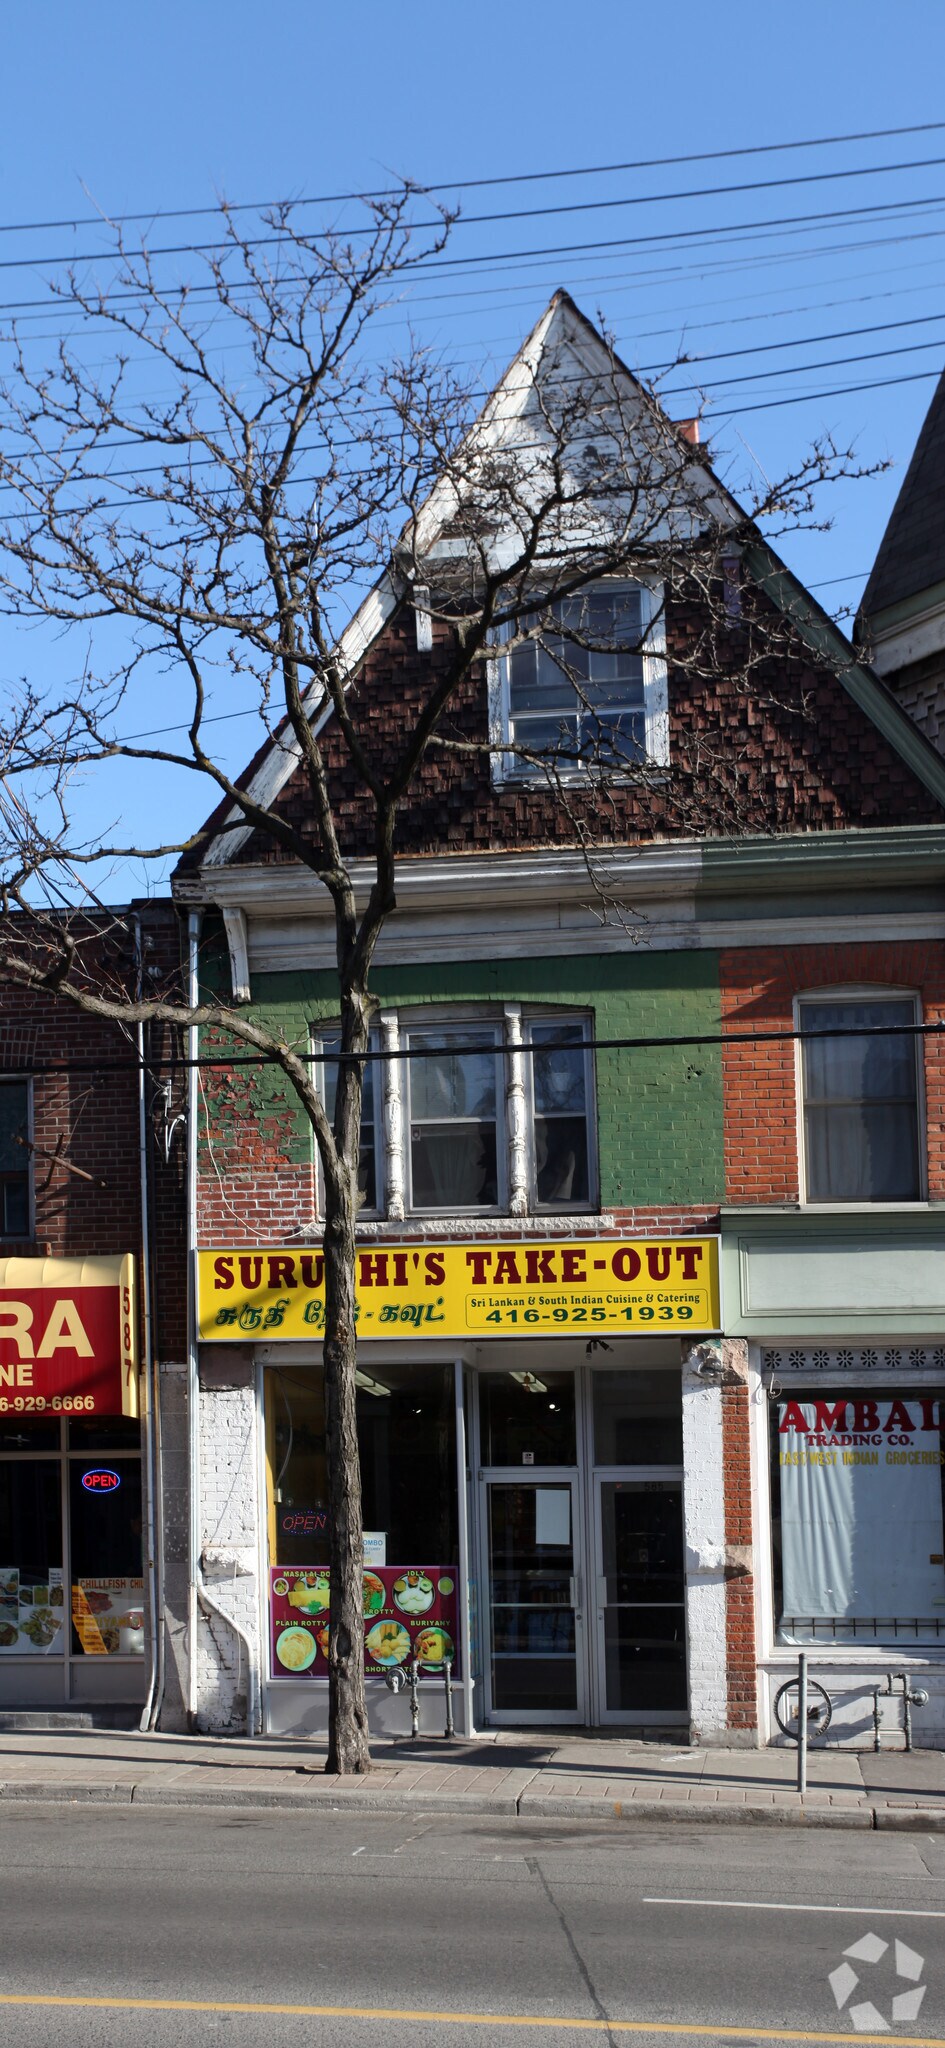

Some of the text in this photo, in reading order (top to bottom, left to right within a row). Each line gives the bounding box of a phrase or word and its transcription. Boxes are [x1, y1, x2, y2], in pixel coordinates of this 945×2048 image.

[214, 1246, 703, 1290] SURUHI'S TAKE-OUT
[471, 1293, 701, 1308] Sri Lankan & South Indian Cuisine & Catering
[485, 1306, 693, 1323] 416-925-1939
[0, 1299, 95, 1359] RA
[122, 1287, 132, 1387] 587
[0, 1395, 95, 1412] 6-929-6666
[778, 1400, 945, 1432] AMBAL
[807, 1434, 914, 1446] TRADING CO.
[842, 1451, 879, 1465] INDIAN
[885, 1451, 945, 1465] GROCERIES
[84, 1475, 117, 1487] OPEN
[282, 1515, 327, 1531] OPEN
[108, 1579, 126, 1589] FISH
